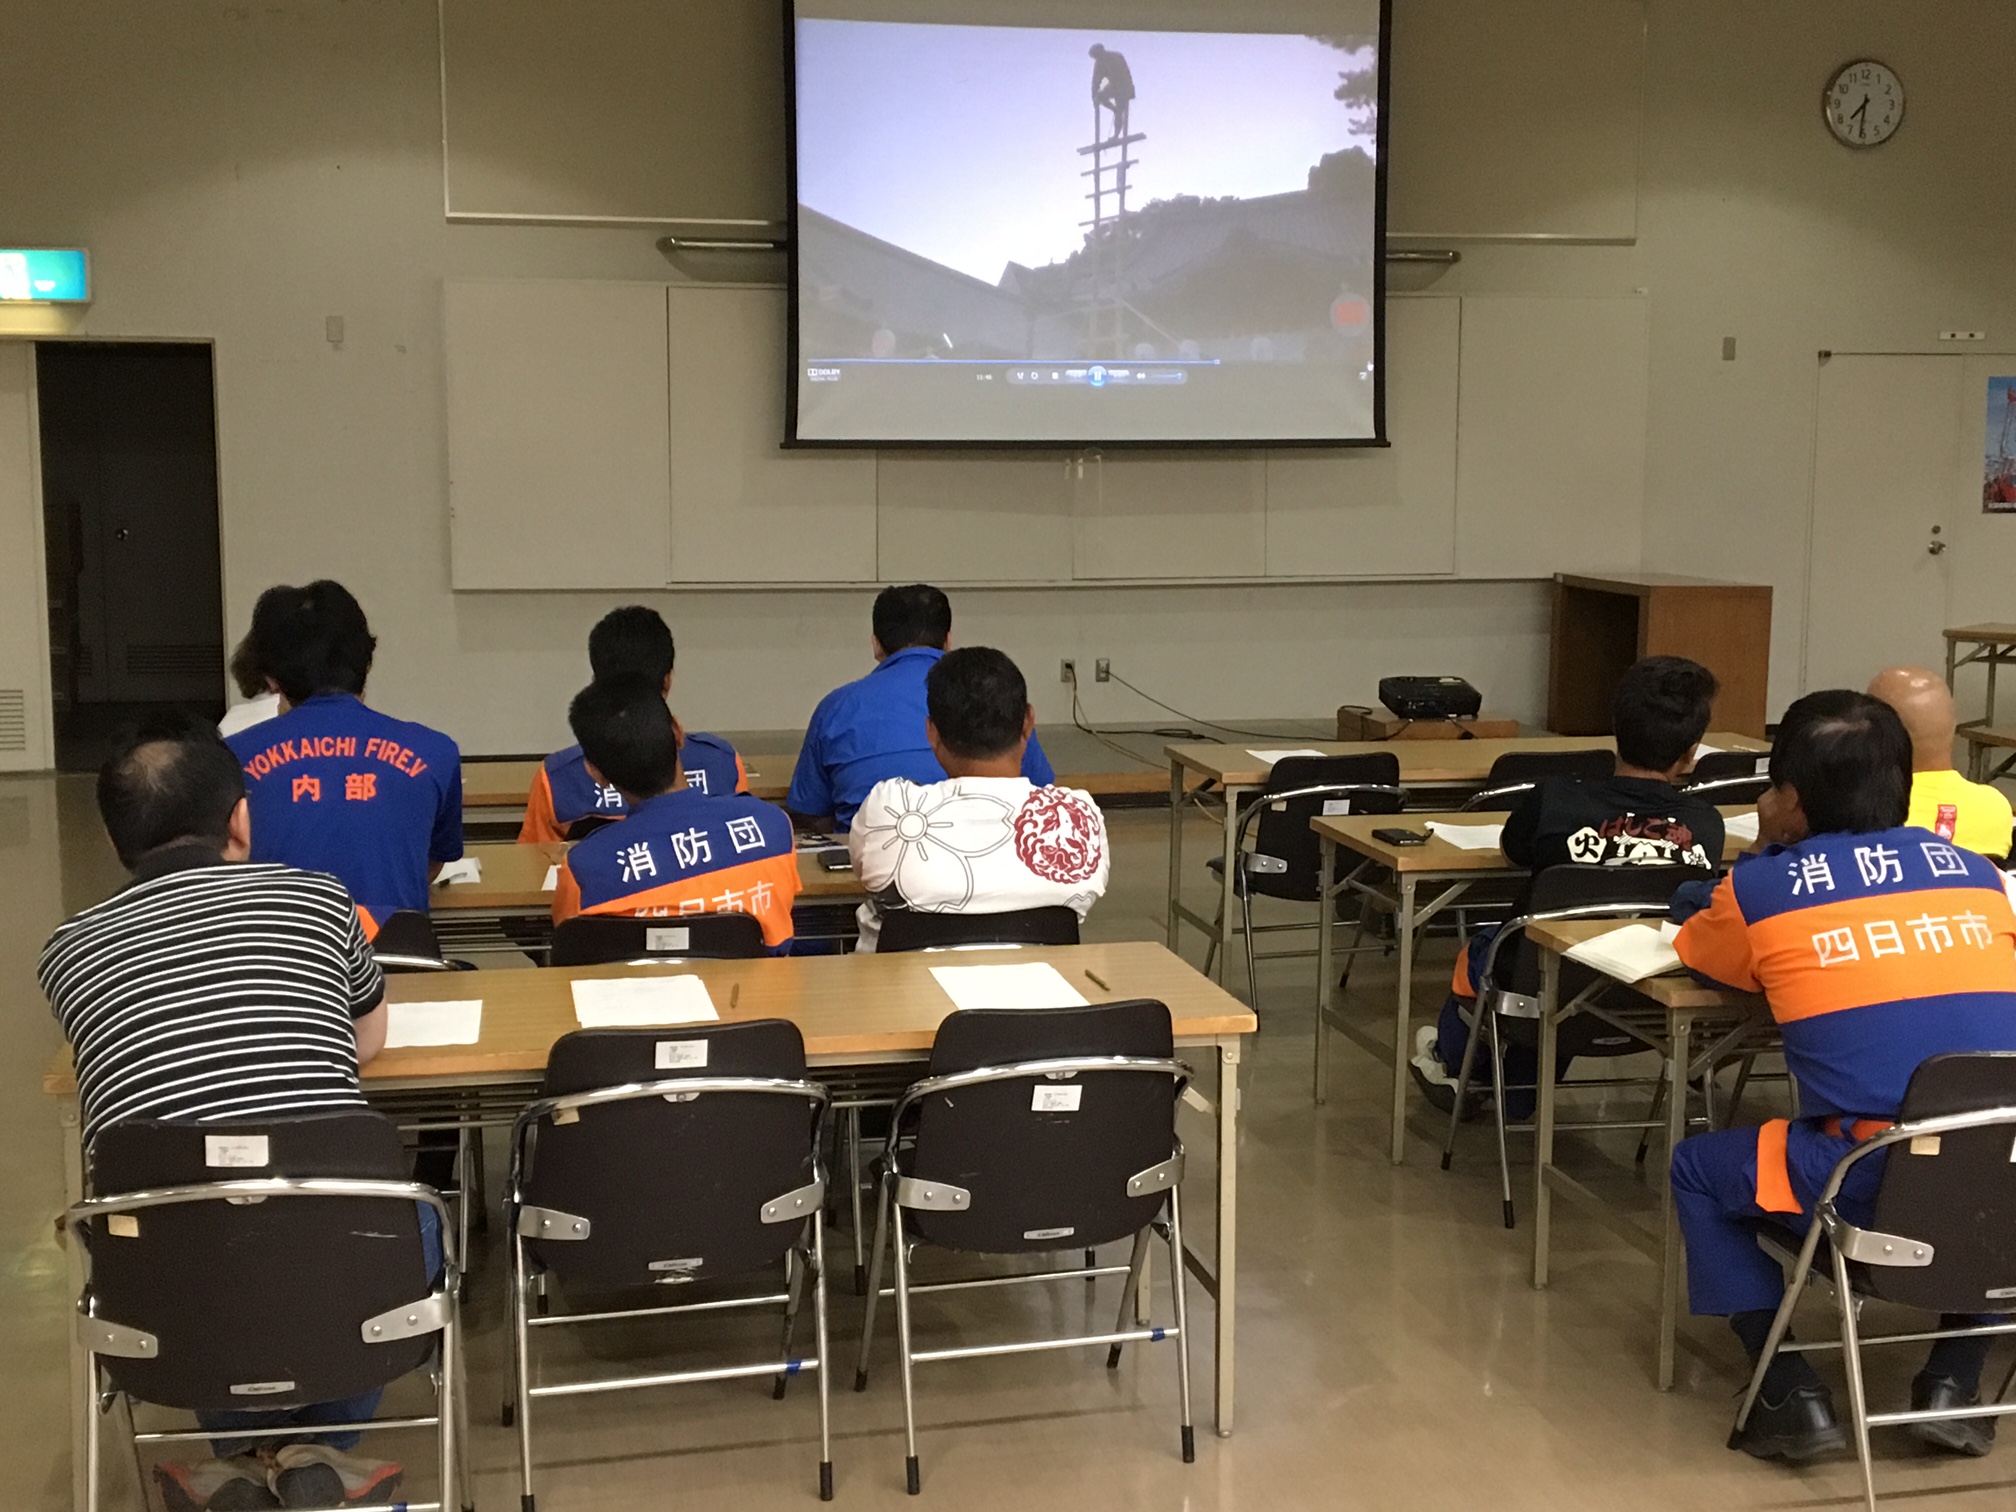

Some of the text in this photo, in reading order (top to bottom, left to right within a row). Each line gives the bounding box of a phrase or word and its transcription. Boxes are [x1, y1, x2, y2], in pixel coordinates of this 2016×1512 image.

[1849, 73, 1857, 84] 11
[1861, 69, 1871, 80] 12
[1877, 73, 1881, 84] 1
[1839, 84, 1849, 94] 10
[1884, 84, 1892, 95] 2
[1834, 99, 1841, 109] 9
[1889, 99, 1895, 110] 3
[1837, 113, 1844, 124] 8
[1883, 114, 1890, 125] 4
[1847, 125, 1854, 135] 7
[1860, 128, 1867, 139] 6
[1873, 126, 1880, 136] 5
[244, 736, 428, 781] YOKKAICHI FIRE.V
[292, 772, 377, 802] 内部
[616, 815, 766, 882] 消防団
[1574, 833, 1600, 859] 火
[1787, 842, 1969, 896] 消防団
[1811, 909, 1993, 968] 四日市市
